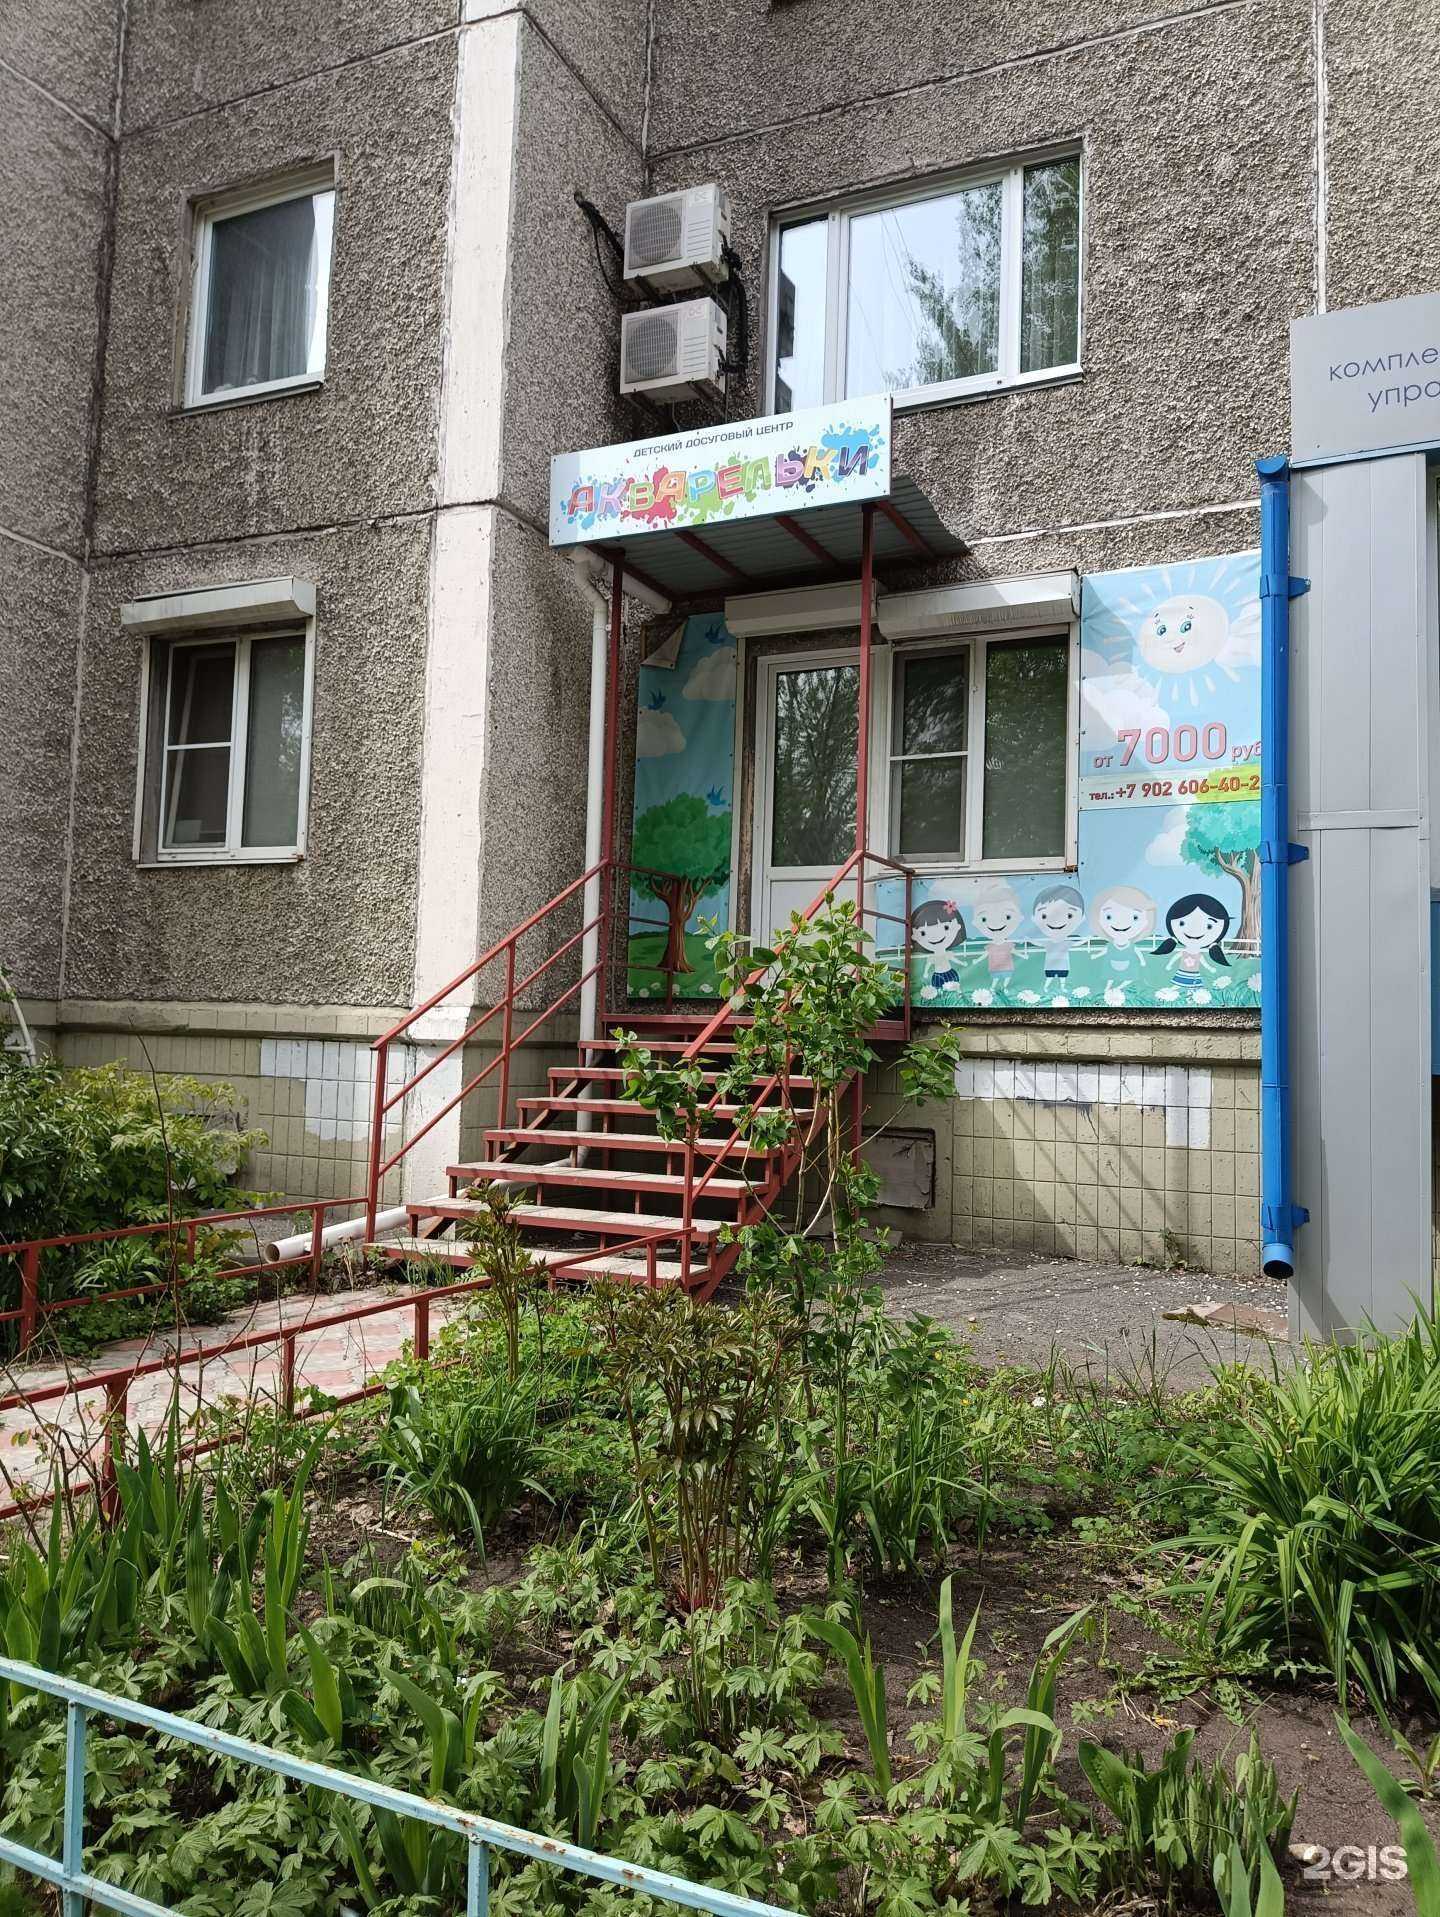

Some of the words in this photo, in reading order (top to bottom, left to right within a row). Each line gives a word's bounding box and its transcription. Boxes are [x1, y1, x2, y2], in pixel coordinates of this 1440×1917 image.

[1329, 348, 1439, 381] компле
[633, 440, 683, 458] ДЕТСКИЙ
[685, 426, 753, 449] ДОСУГОВЫЙ
[756, 421, 794, 436] ЦЕНТР
[568, 445, 870, 516] АКВАРЕЛЬКИ
[1093, 755, 1113, 768] от
[1117, 722, 1227, 767] 7000
[1141, 781, 1173, 797] 902
